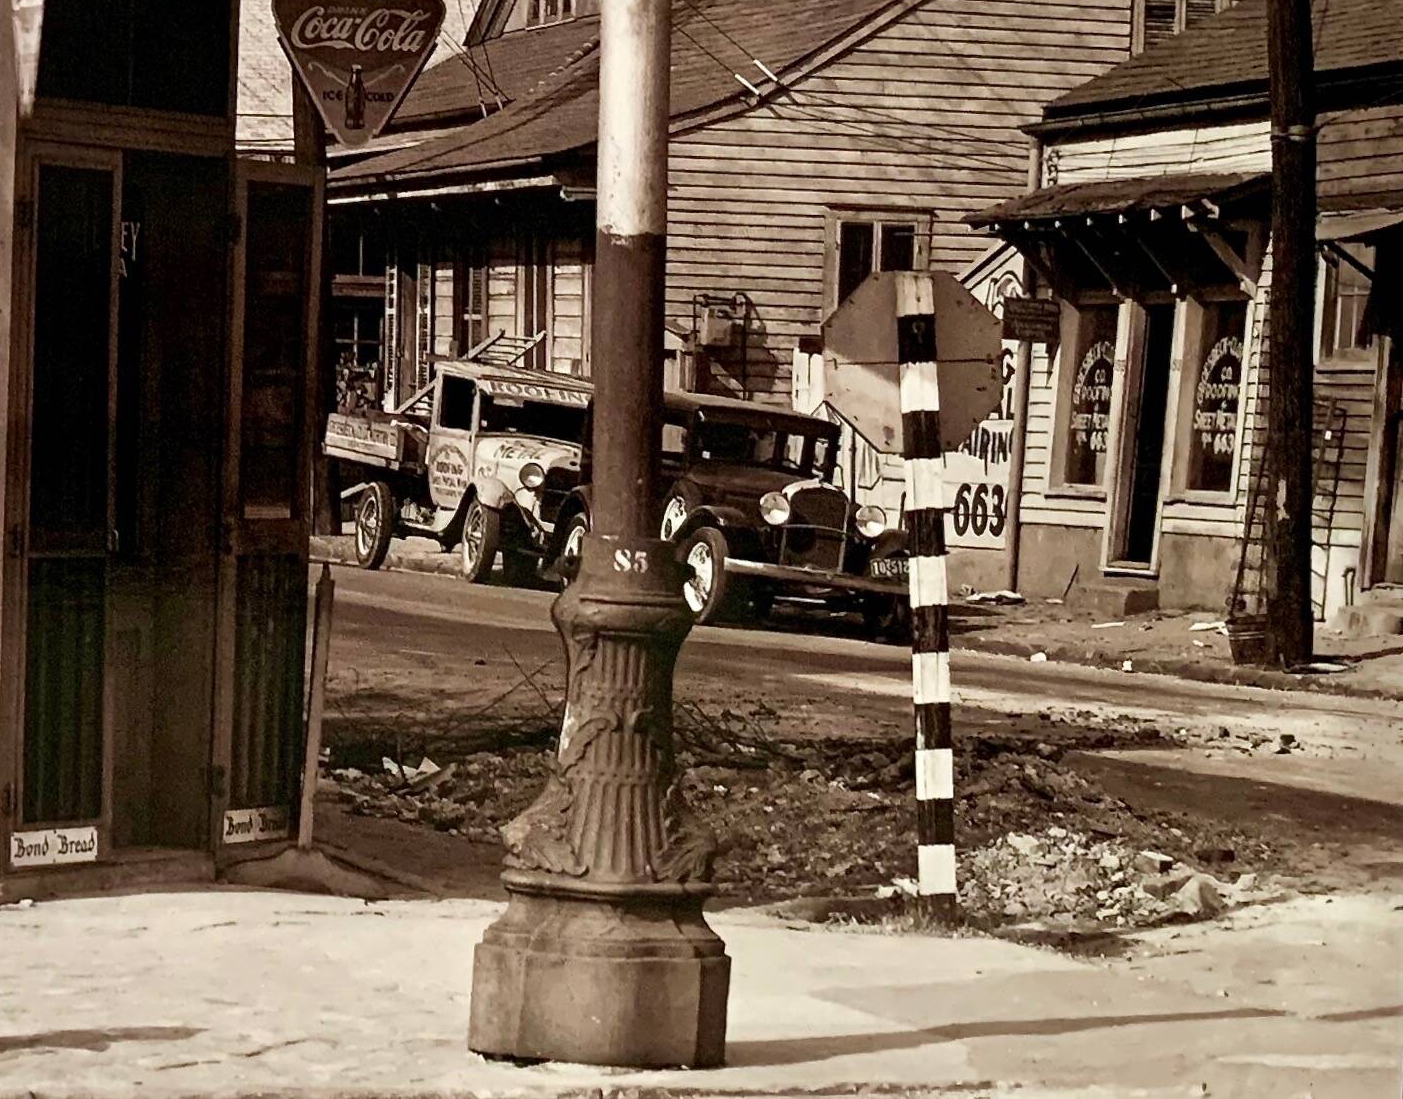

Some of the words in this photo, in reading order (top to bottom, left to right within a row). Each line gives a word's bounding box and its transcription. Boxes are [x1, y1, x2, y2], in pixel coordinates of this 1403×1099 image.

[290, 5, 432, 52] Coca-Cola
[323, 90, 344, 101] ICE
[365, 90, 395, 102] COLD
[952, 482, 1005, 538] 663
[612, 548, 649, 574] 85
[227, 814, 254, 836] Bond
[13, 835, 50, 858] Bond
[56, 832, 96, 854] Bread
